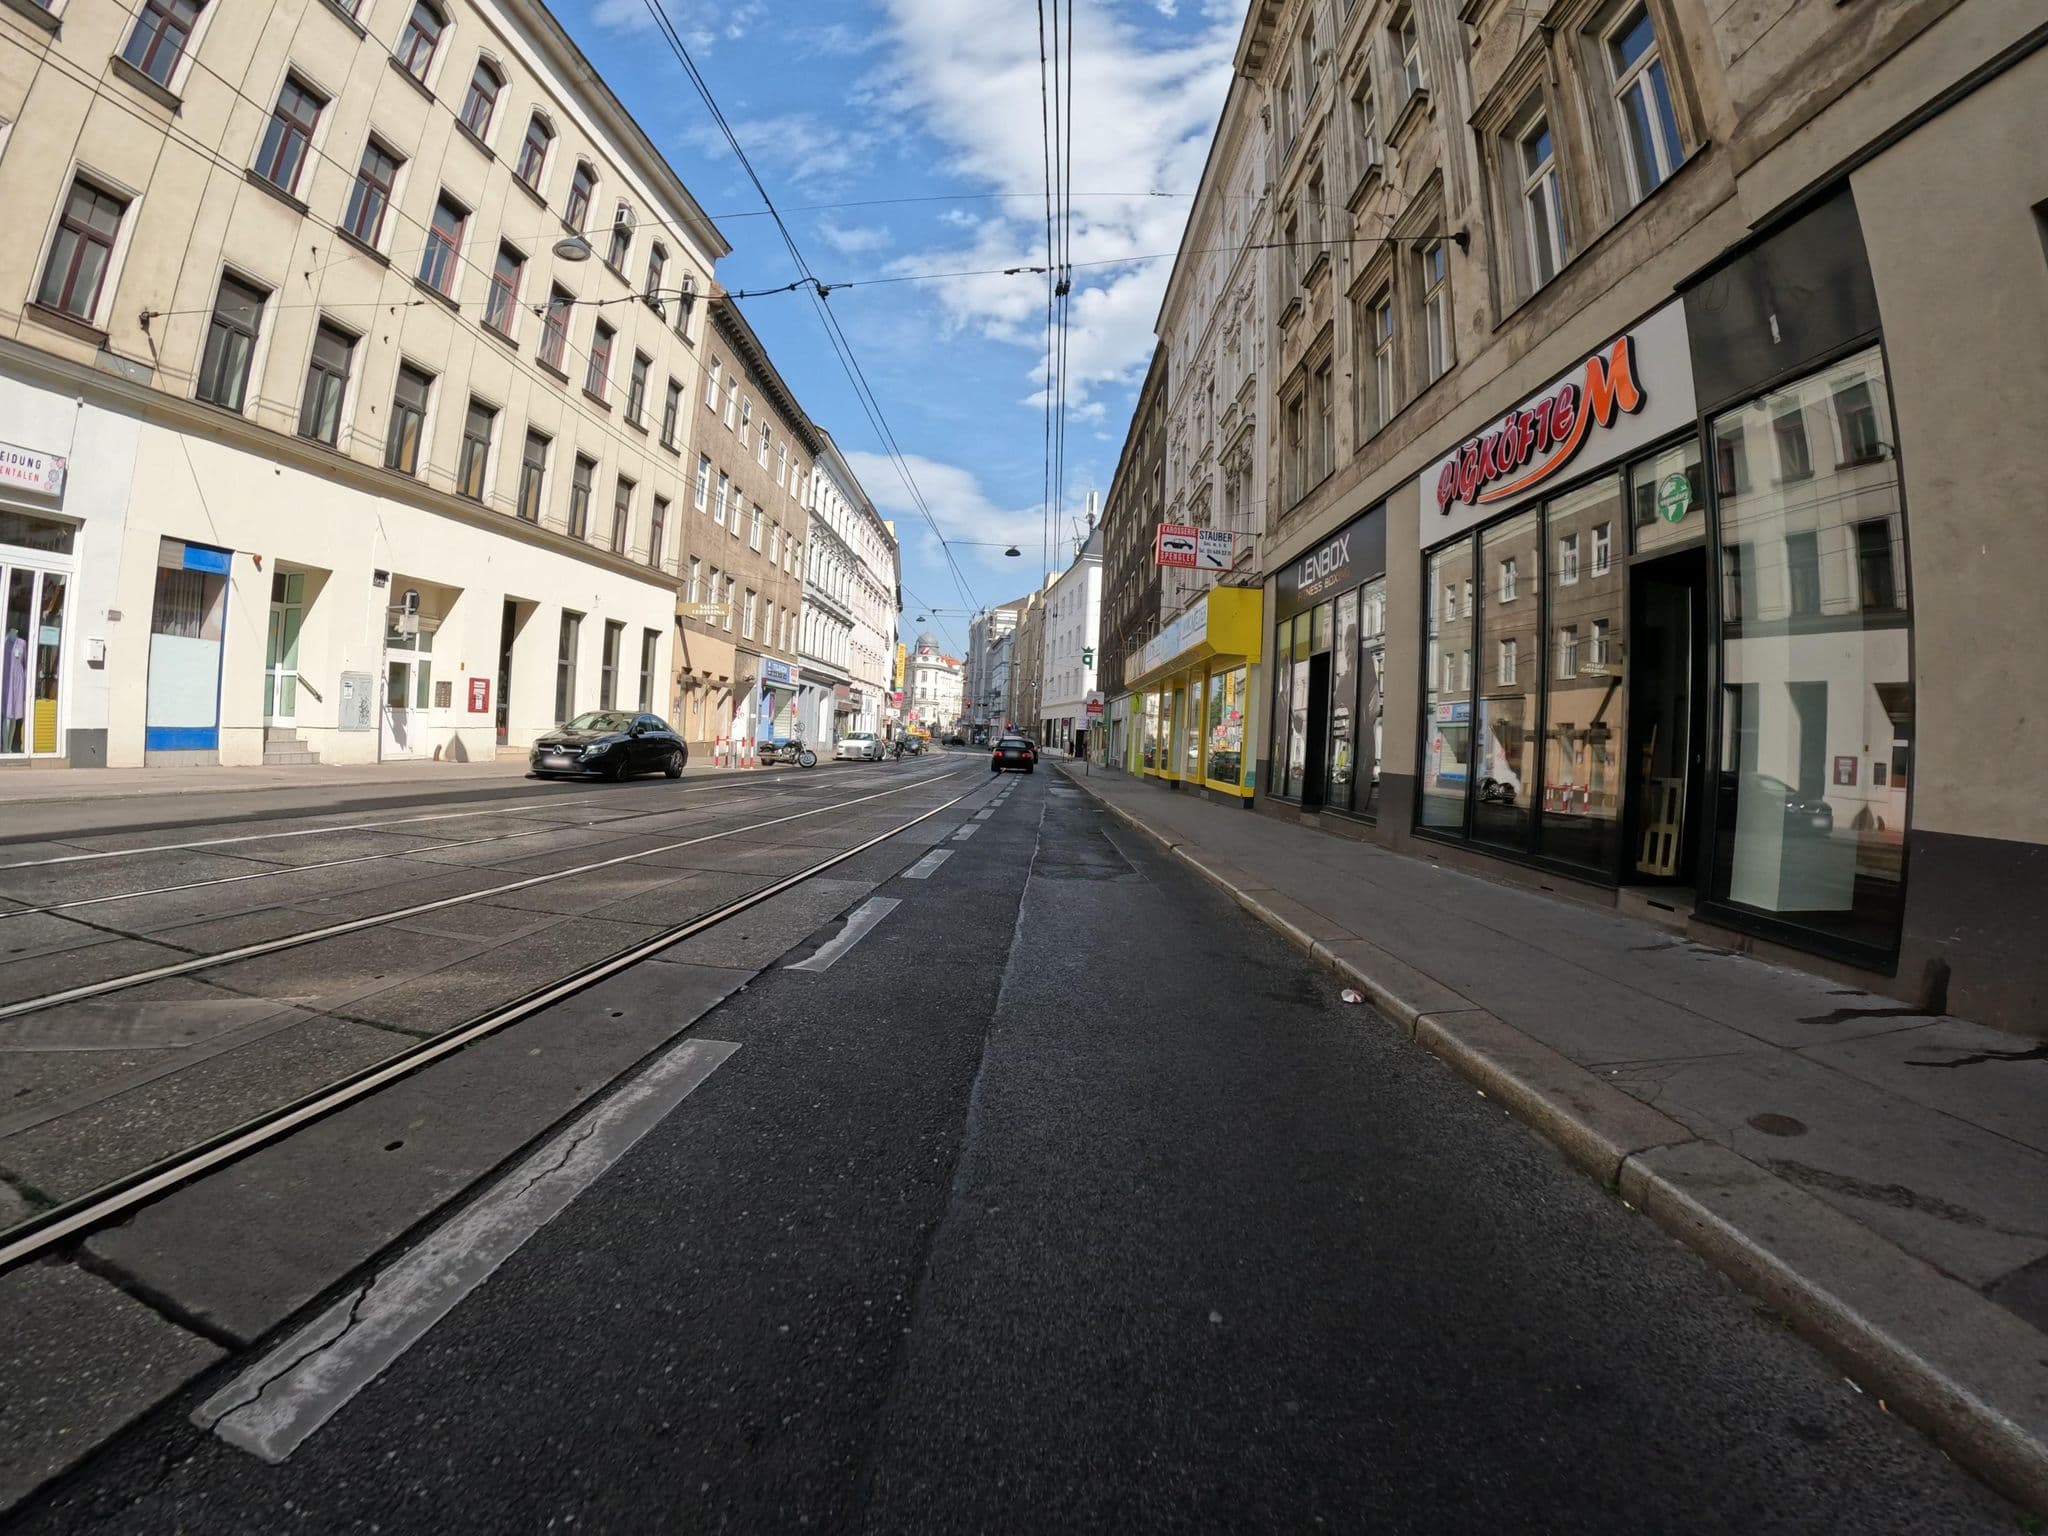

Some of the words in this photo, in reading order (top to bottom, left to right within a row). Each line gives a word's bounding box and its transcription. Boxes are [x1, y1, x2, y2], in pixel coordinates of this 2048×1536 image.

[1161, 525, 1198, 536] KAROSSERIE
[1199, 530, 1233, 543] STAUBER
[1160, 552, 1196, 563] SPENGLER
[1297, 532, 1351, 590] LENBOX
